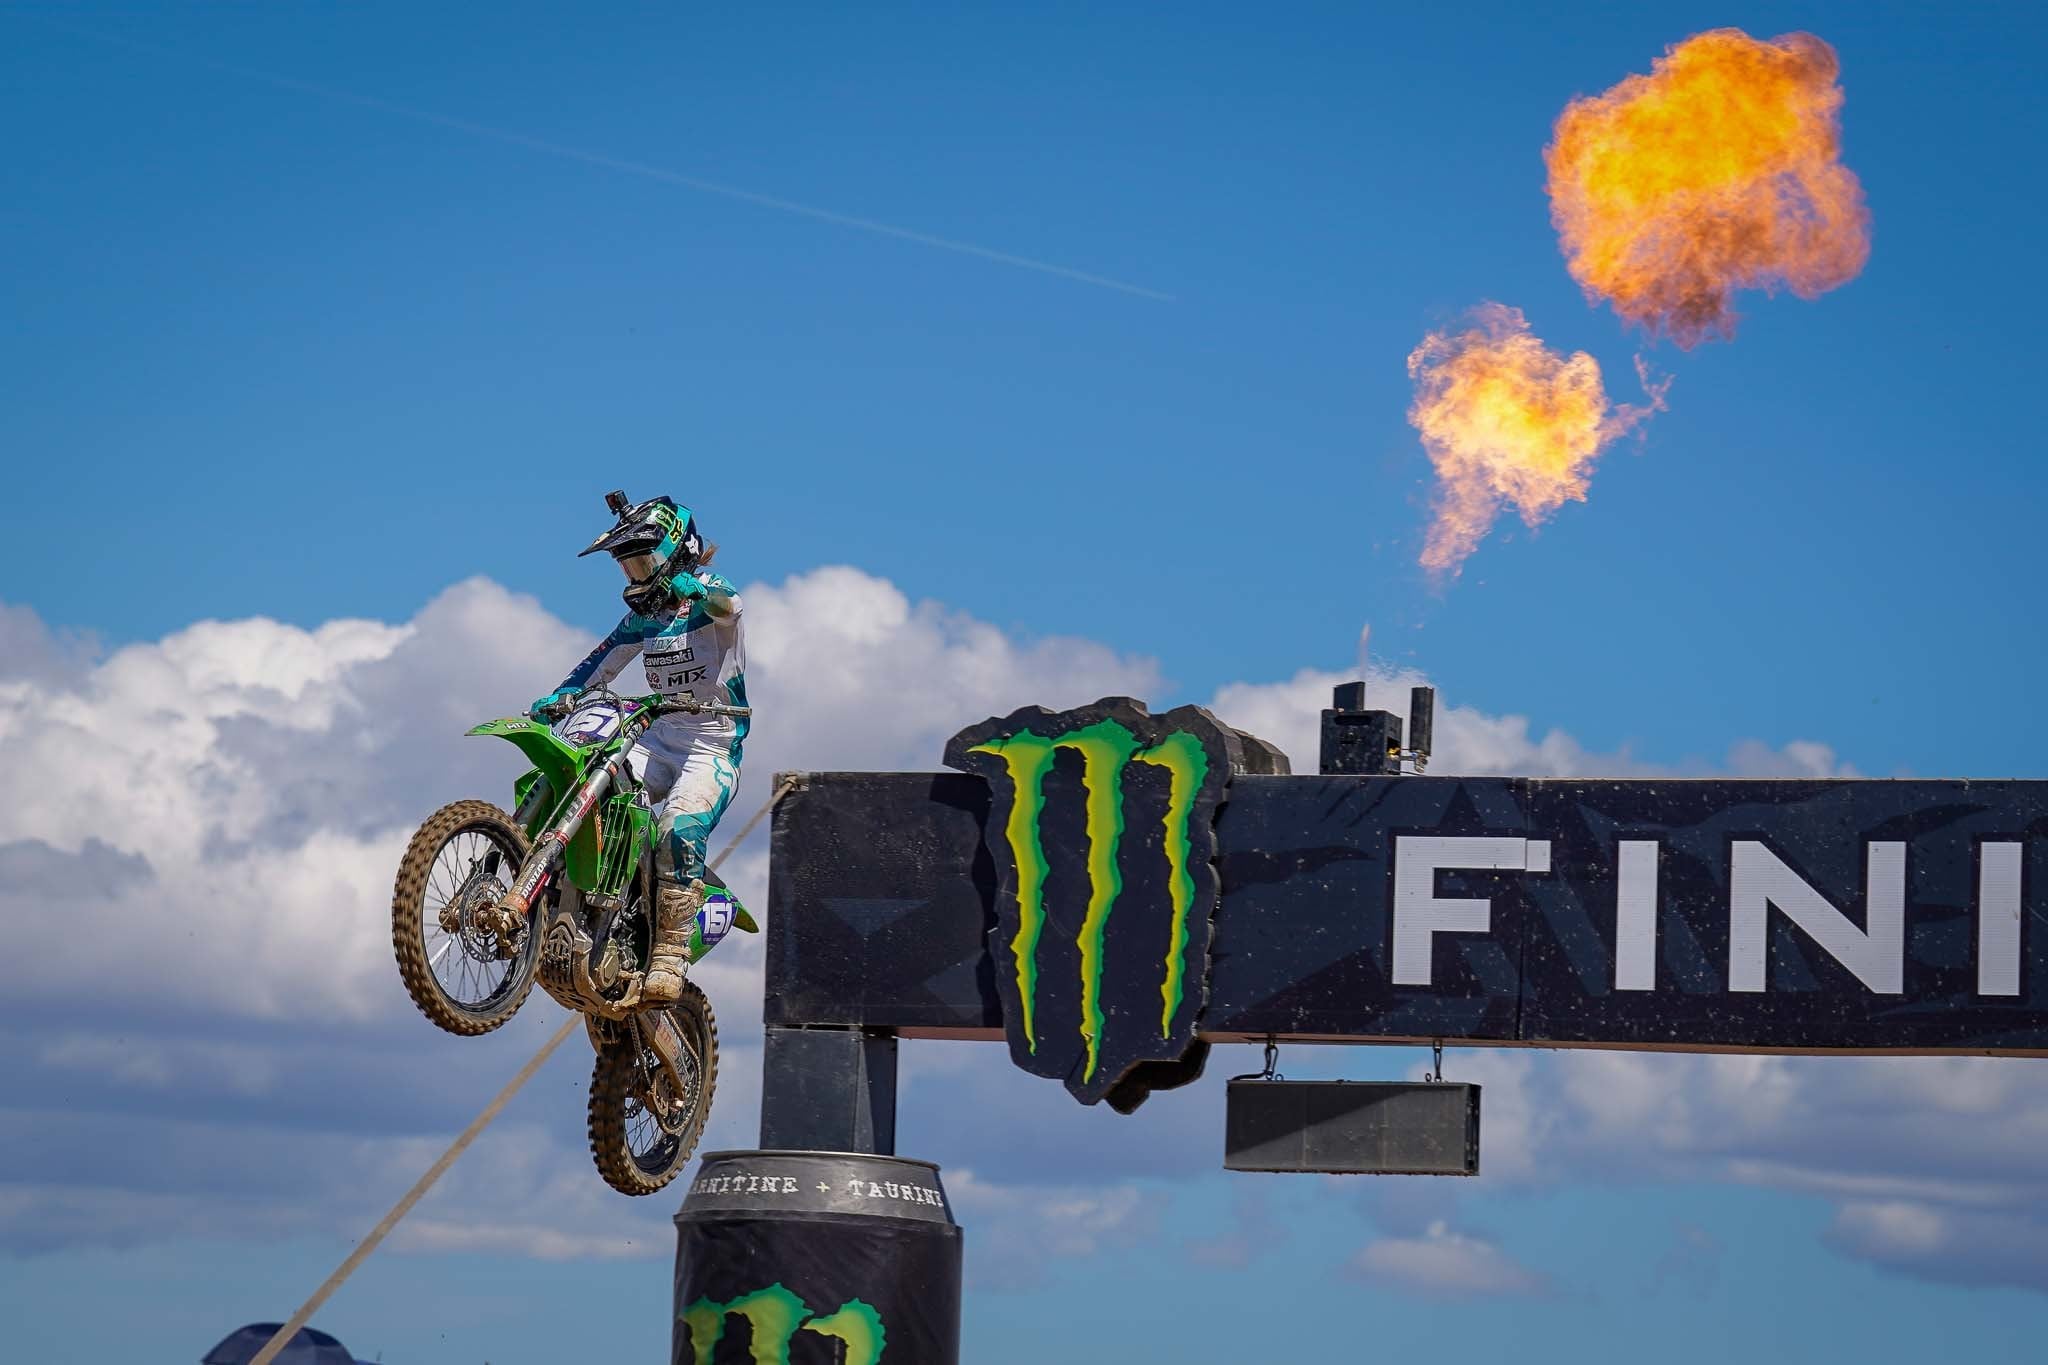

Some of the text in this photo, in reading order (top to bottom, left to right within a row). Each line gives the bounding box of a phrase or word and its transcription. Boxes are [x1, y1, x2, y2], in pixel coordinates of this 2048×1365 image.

[644, 650, 693, 666] awasaki
[668, 664, 708, 687] MTX
[521, 857, 547, 899] DUNLOP
[702, 902, 733, 934] 151
[1391, 834, 2023, 996] FINI
